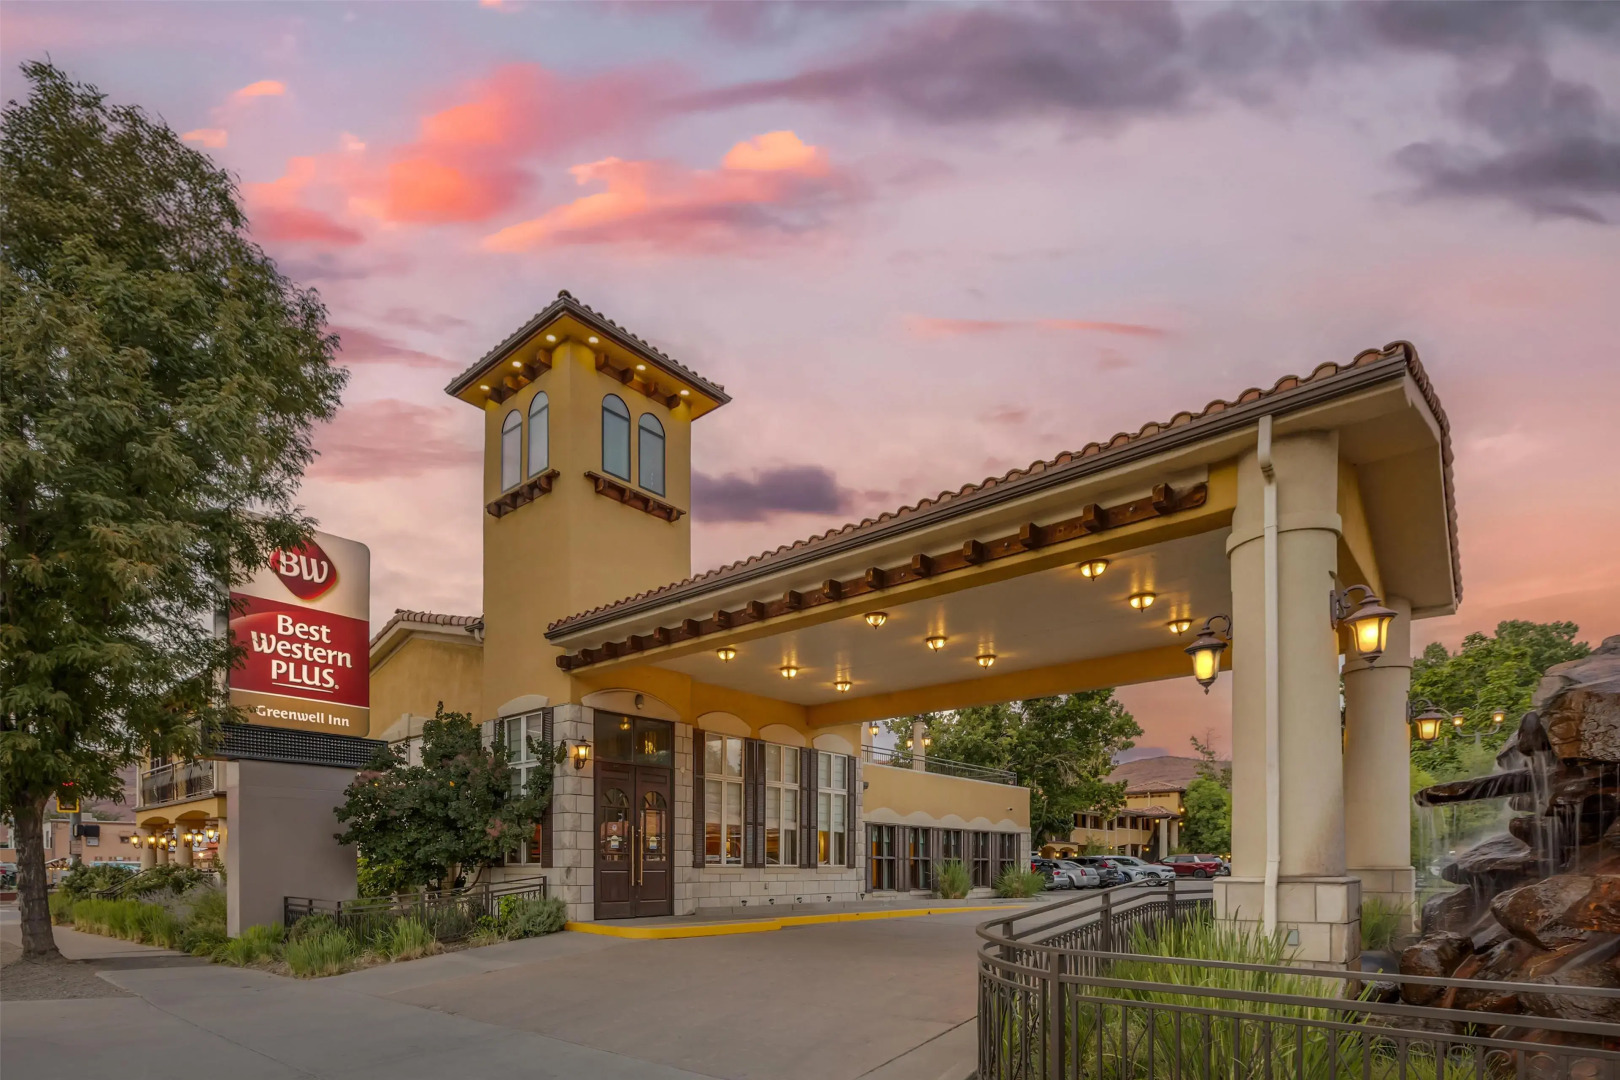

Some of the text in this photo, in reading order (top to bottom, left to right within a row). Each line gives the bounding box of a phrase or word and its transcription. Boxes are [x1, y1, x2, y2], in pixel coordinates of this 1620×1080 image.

[279, 551, 328, 583] BW
[277, 614, 331, 643] Best
[251, 630, 352, 668] Western
[256, 705, 350, 727] Greenwell Inn
